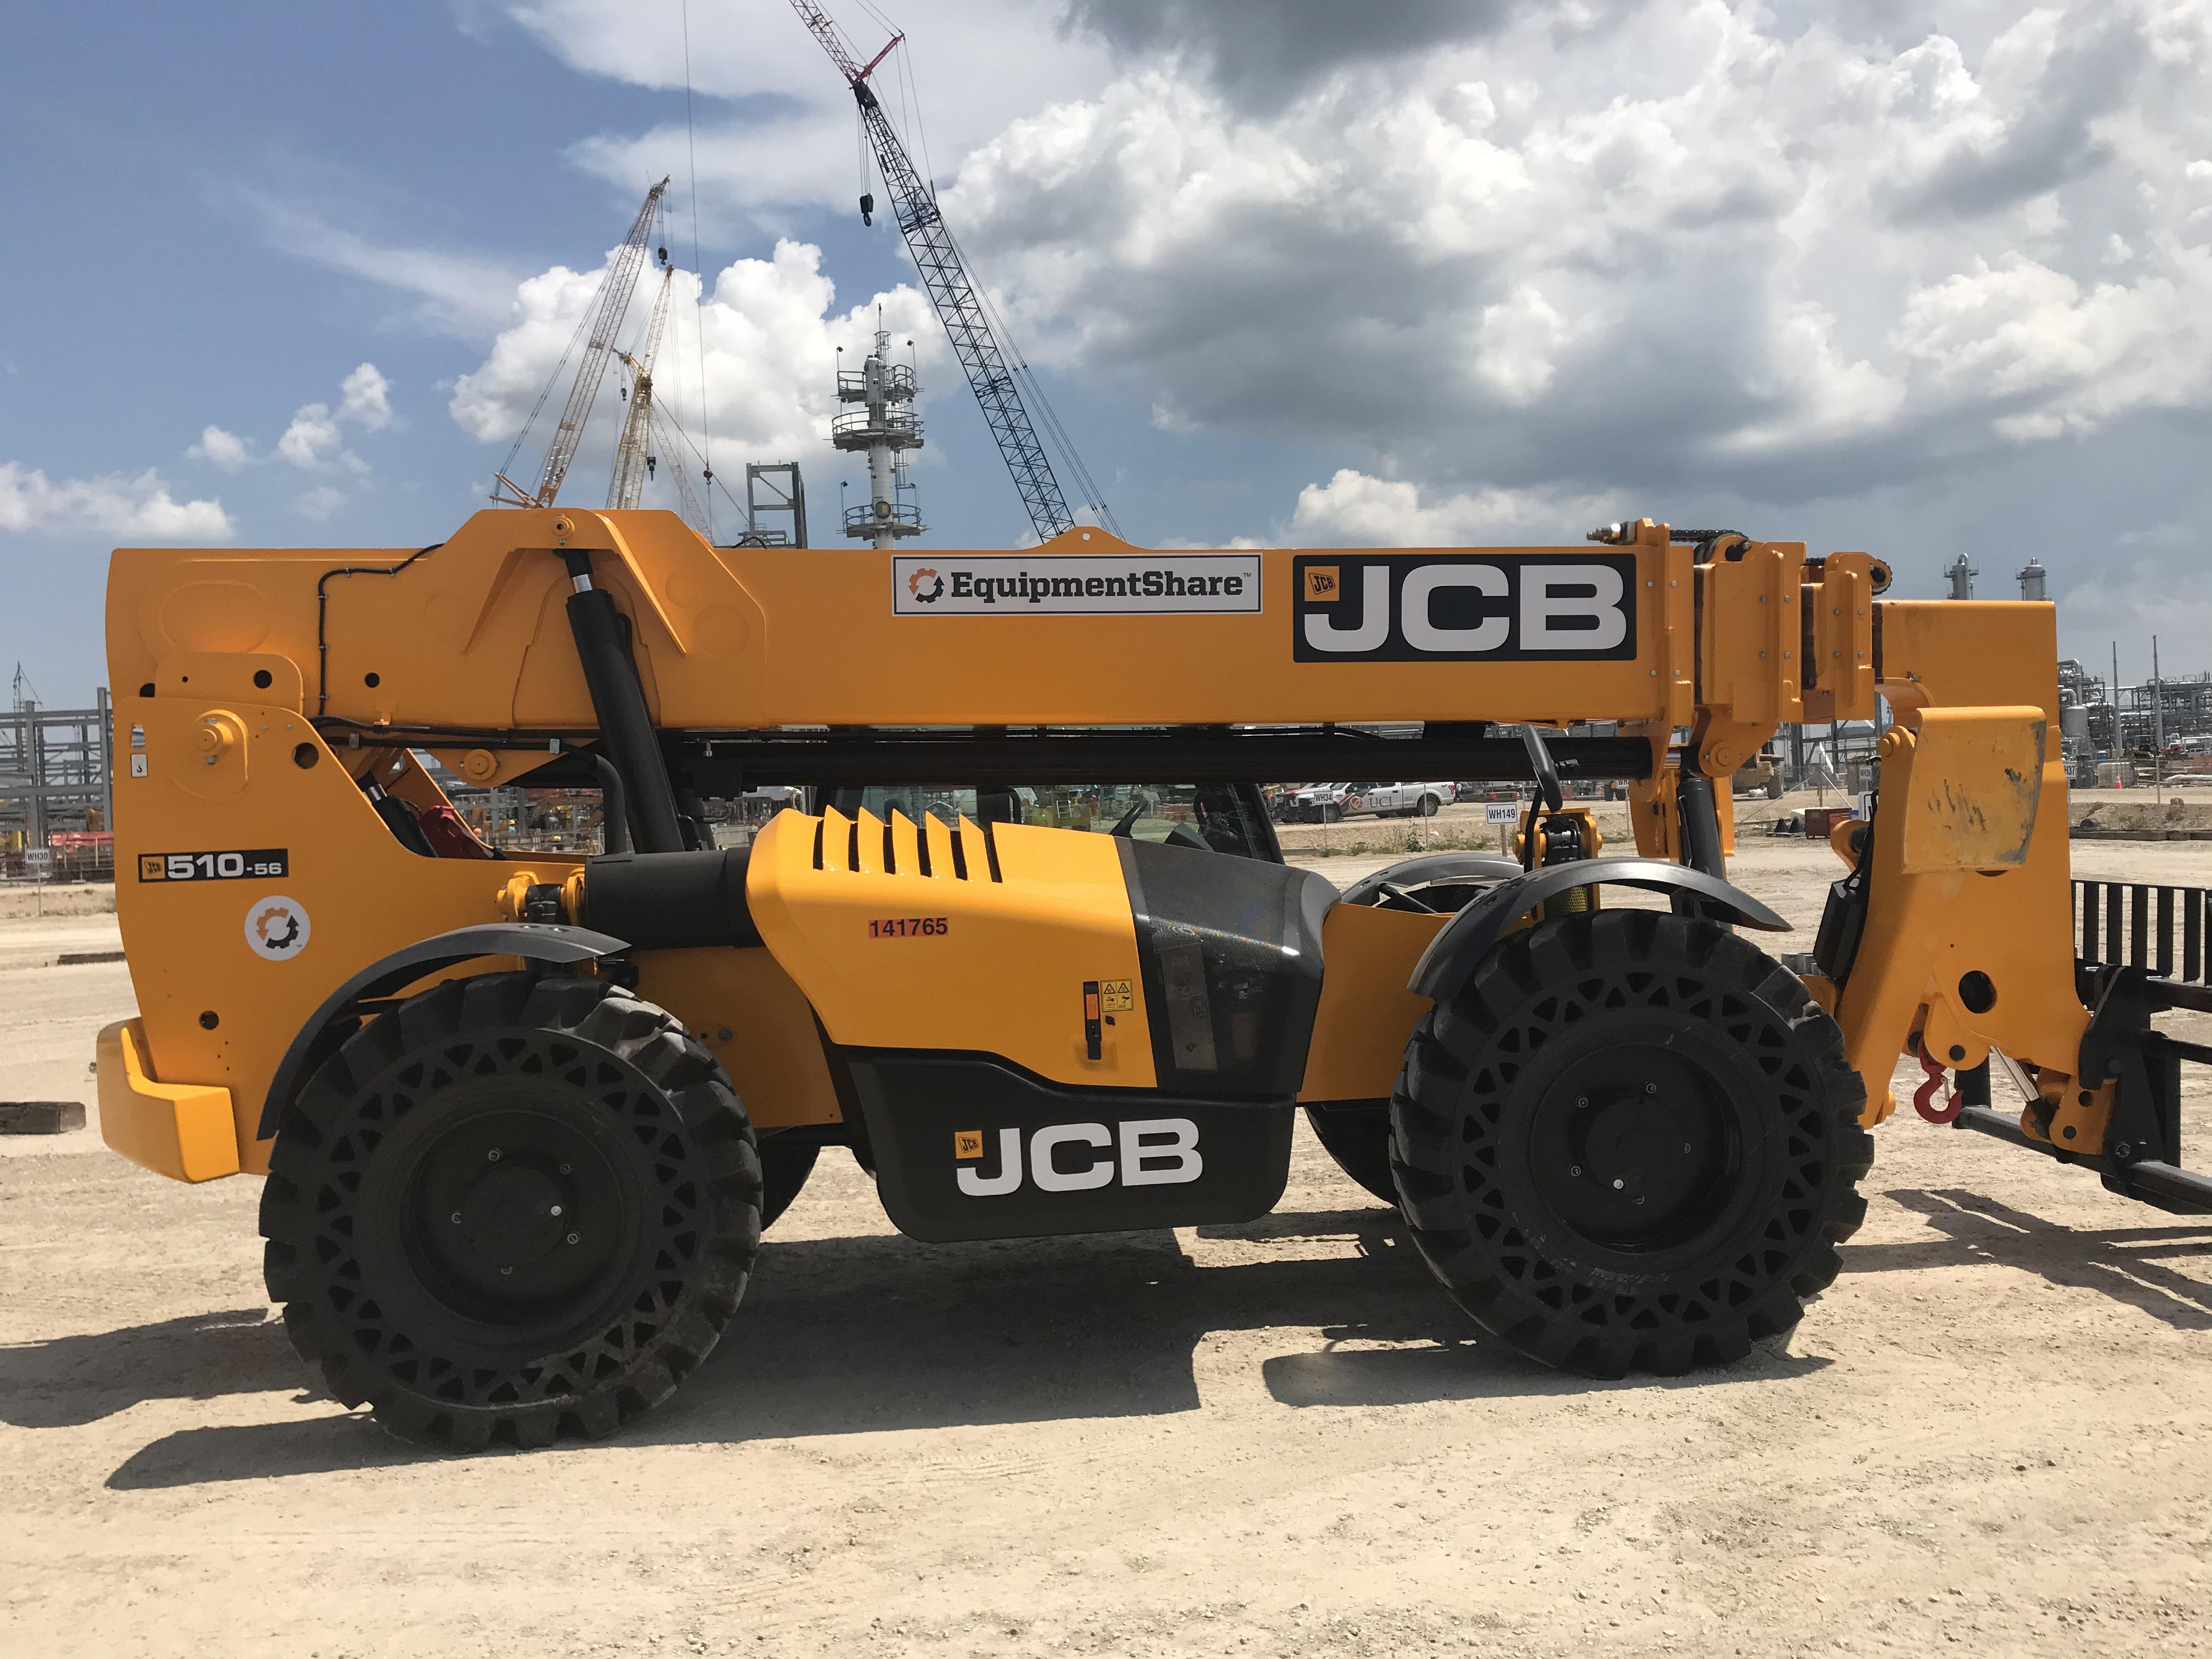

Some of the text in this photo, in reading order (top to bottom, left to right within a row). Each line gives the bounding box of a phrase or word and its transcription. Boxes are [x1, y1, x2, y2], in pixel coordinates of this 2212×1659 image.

[951, 571, 1243, 603] EquipmentShare
[1313, 575, 1334, 592] JCB
[1304, 564, 1627, 652] JCB
[2064, 765, 2075, 775] H37
[1315, 793, 1332, 802] WH34
[1369, 796, 1393, 808] UCI
[1488, 809, 1515, 819] WH149
[27, 852, 48, 861] WH30
[870, 917, 949, 937] 141765
[962, 1139, 978, 1151] JCB
[957, 1118, 1203, 1197] JCB
